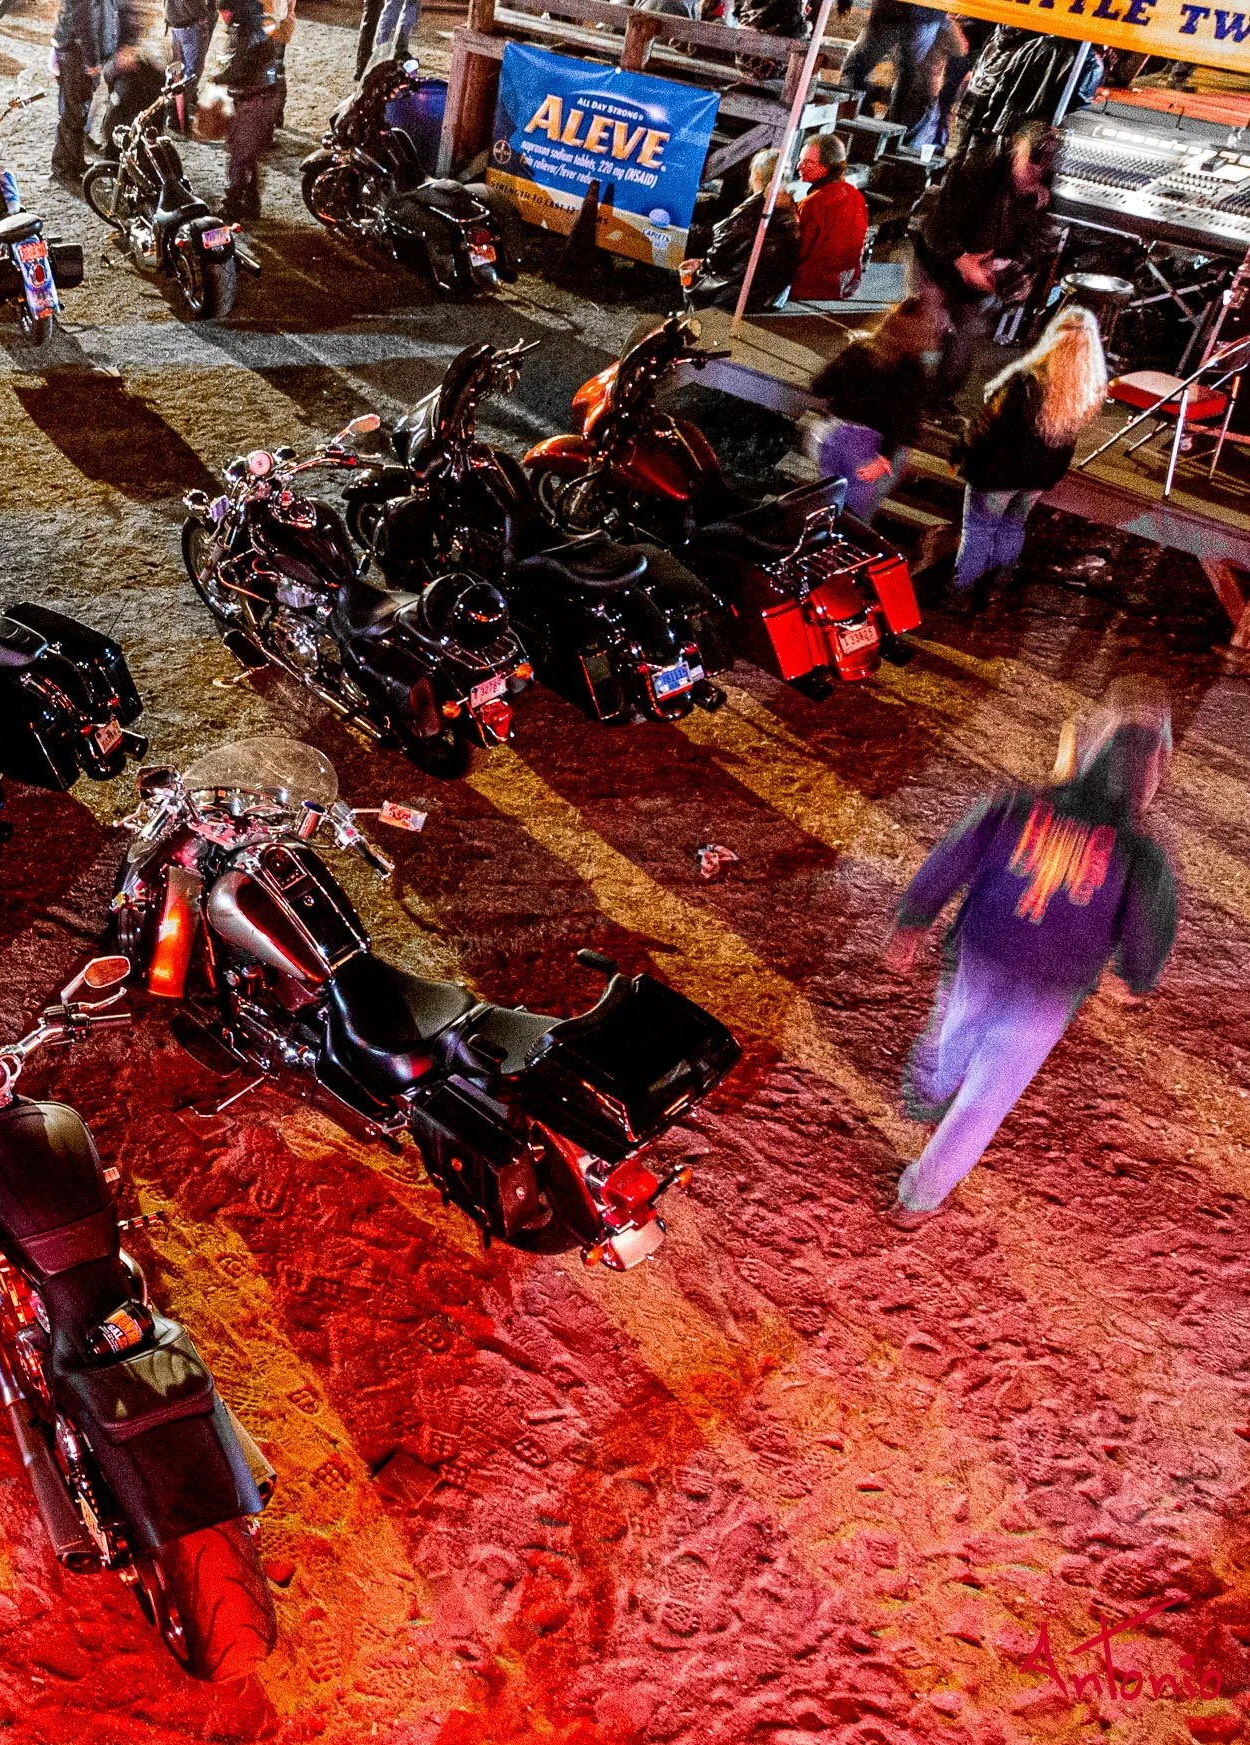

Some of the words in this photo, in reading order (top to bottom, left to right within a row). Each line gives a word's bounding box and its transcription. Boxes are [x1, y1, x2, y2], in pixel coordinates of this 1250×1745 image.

[576, 97, 590, 108] ALL
[590, 101, 607, 112] DAY
[550, 147, 574, 163] sodium
[597, 160, 614, 175] 220
[612, 167, 625, 181] mg
[624, 167, 659, 189] (NSAID)
